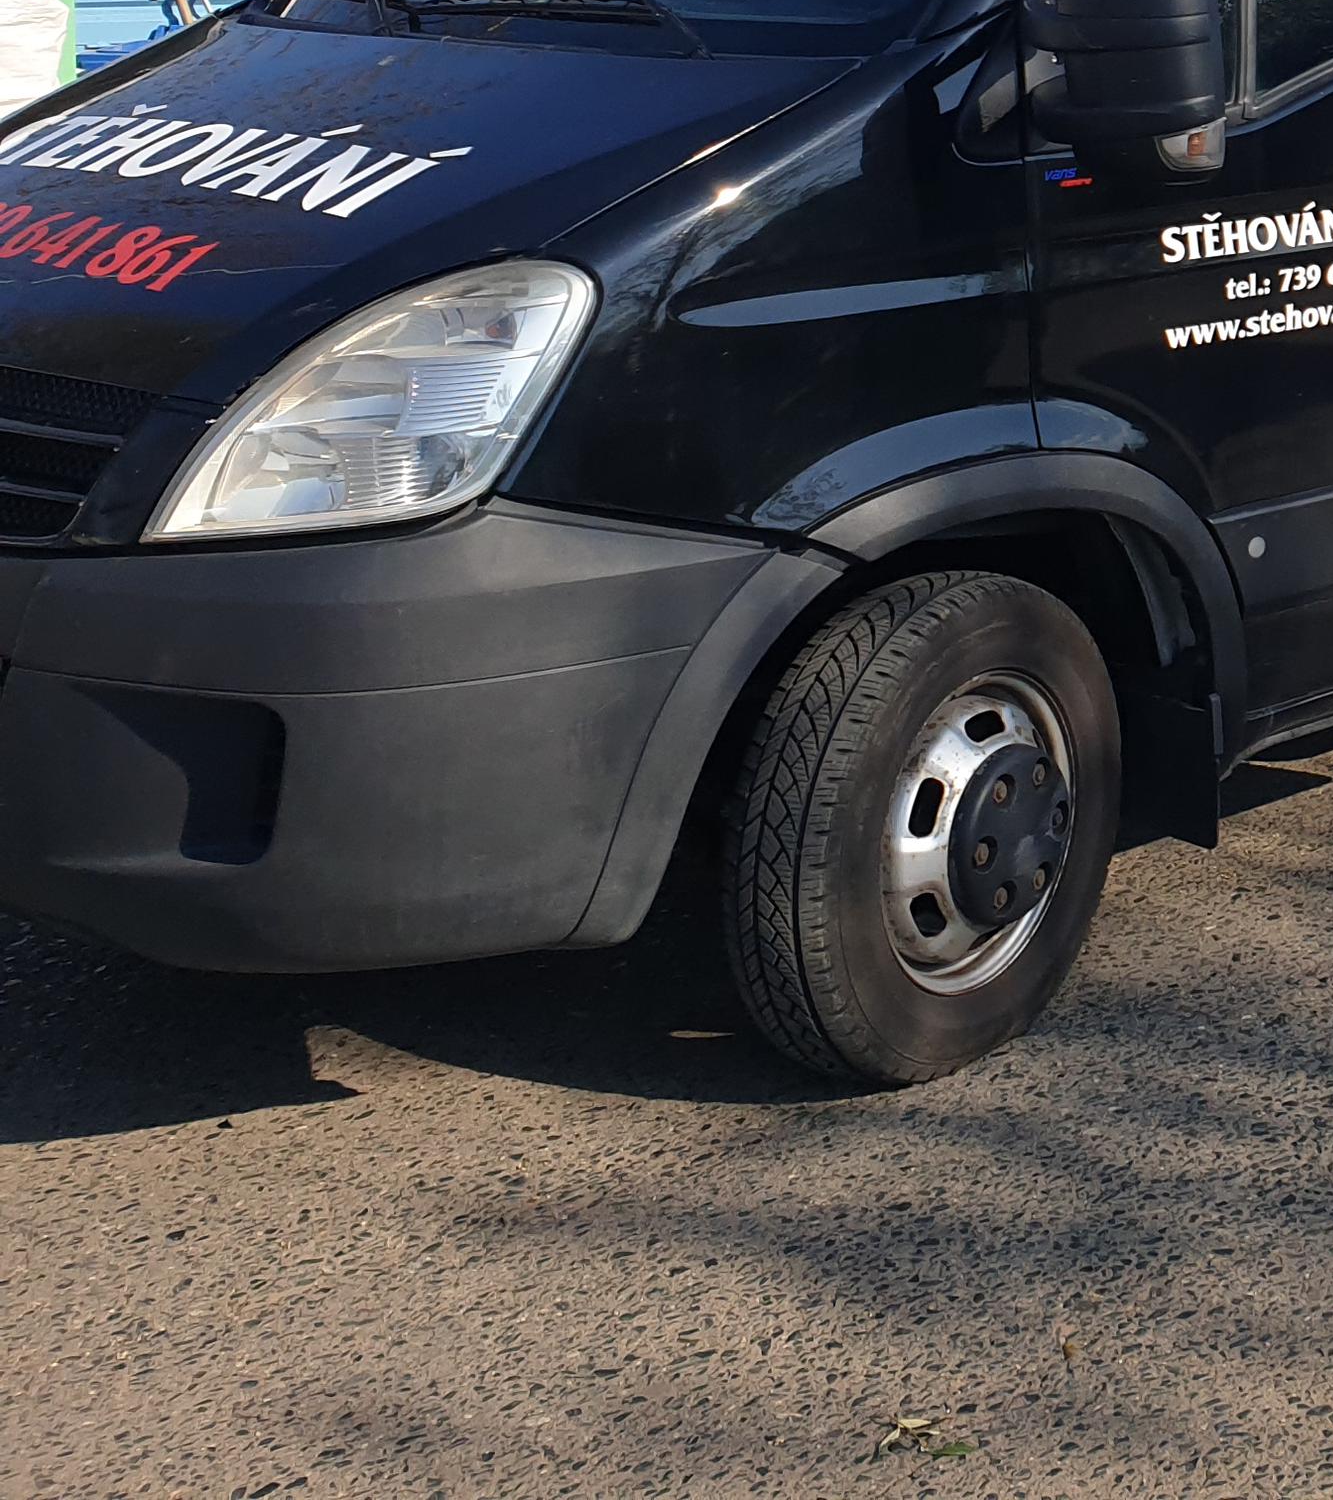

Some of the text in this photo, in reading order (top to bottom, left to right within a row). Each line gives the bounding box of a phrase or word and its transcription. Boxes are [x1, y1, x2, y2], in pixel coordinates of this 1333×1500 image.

[85, 226, 221, 292] 861
[1226, 273, 1271, 300] tel.:
[1278, 264, 1322, 293] 739
